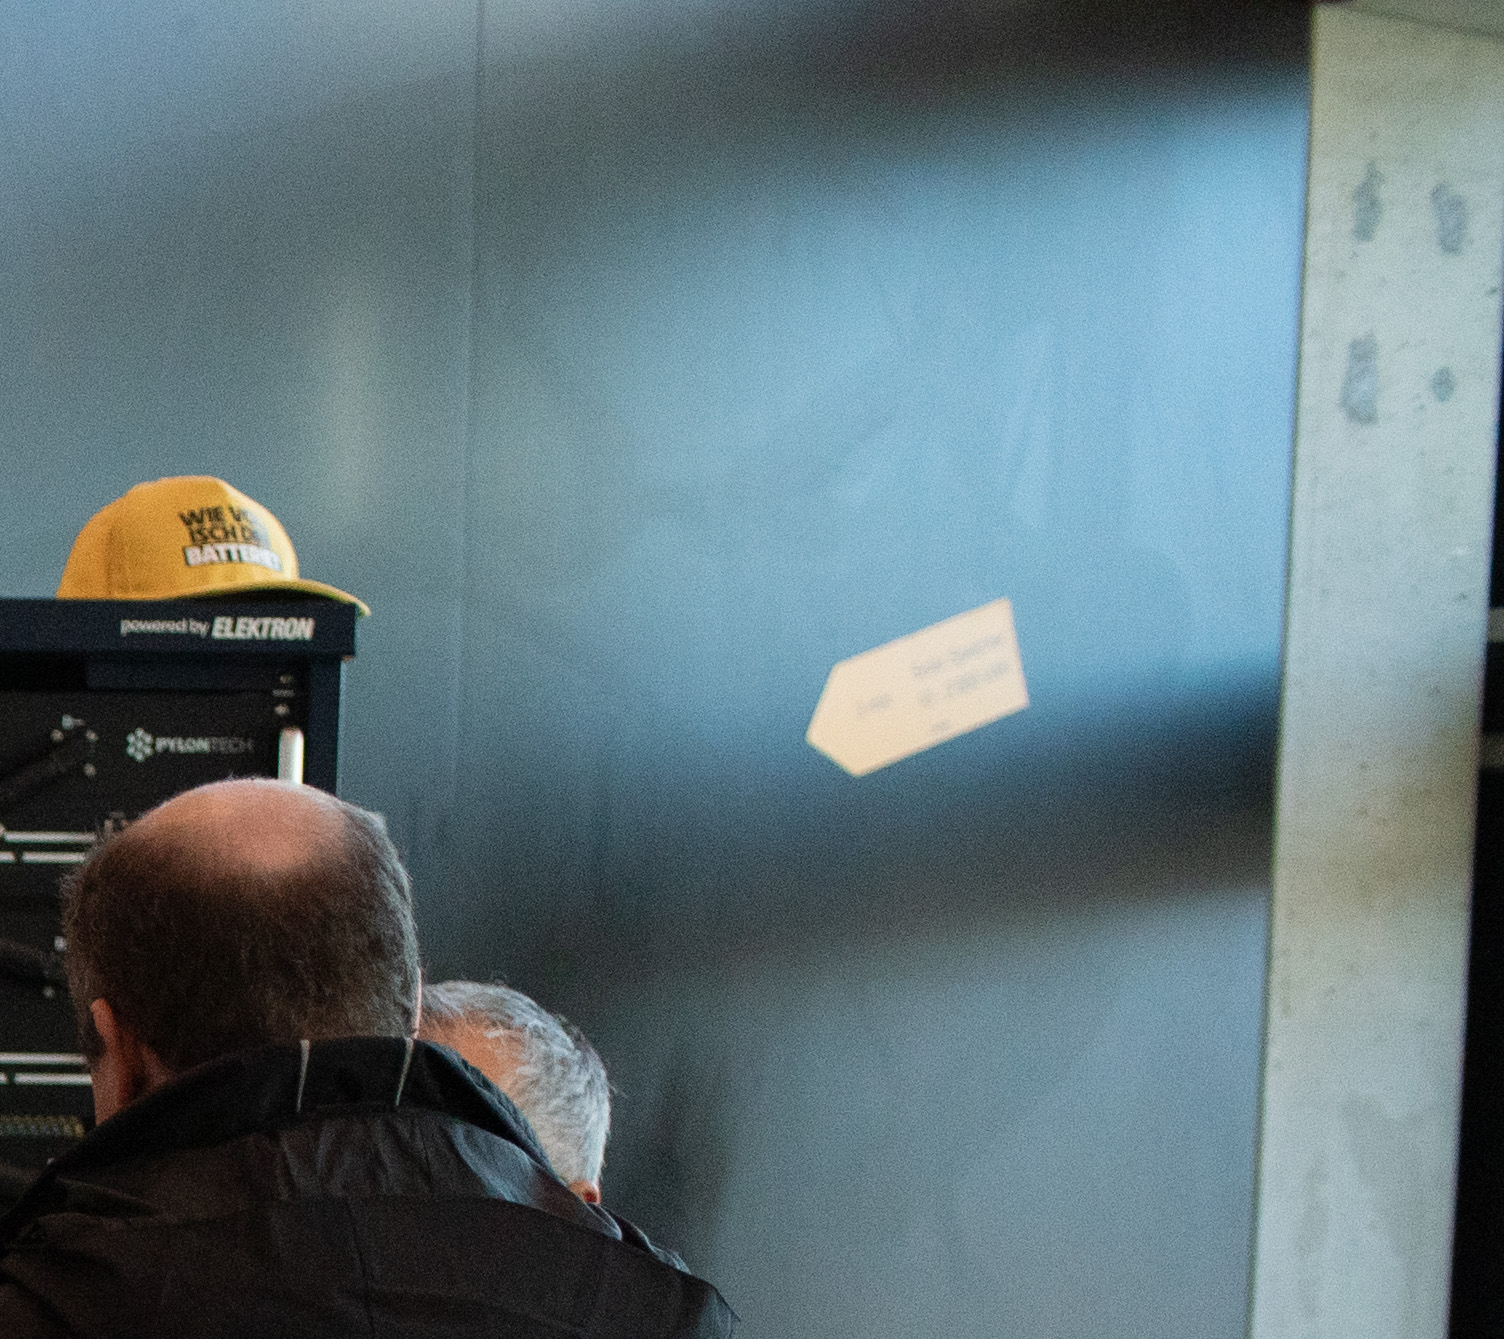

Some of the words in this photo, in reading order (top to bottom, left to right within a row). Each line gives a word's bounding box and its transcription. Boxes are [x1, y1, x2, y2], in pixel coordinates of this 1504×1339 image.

[179, 506, 224, 525] WIE
[120, 618, 186, 635] powered
[189, 617, 209, 637] by
[211, 616, 316, 640] ELEKTRON
[155, 736, 255, 754] PYLONTECH
